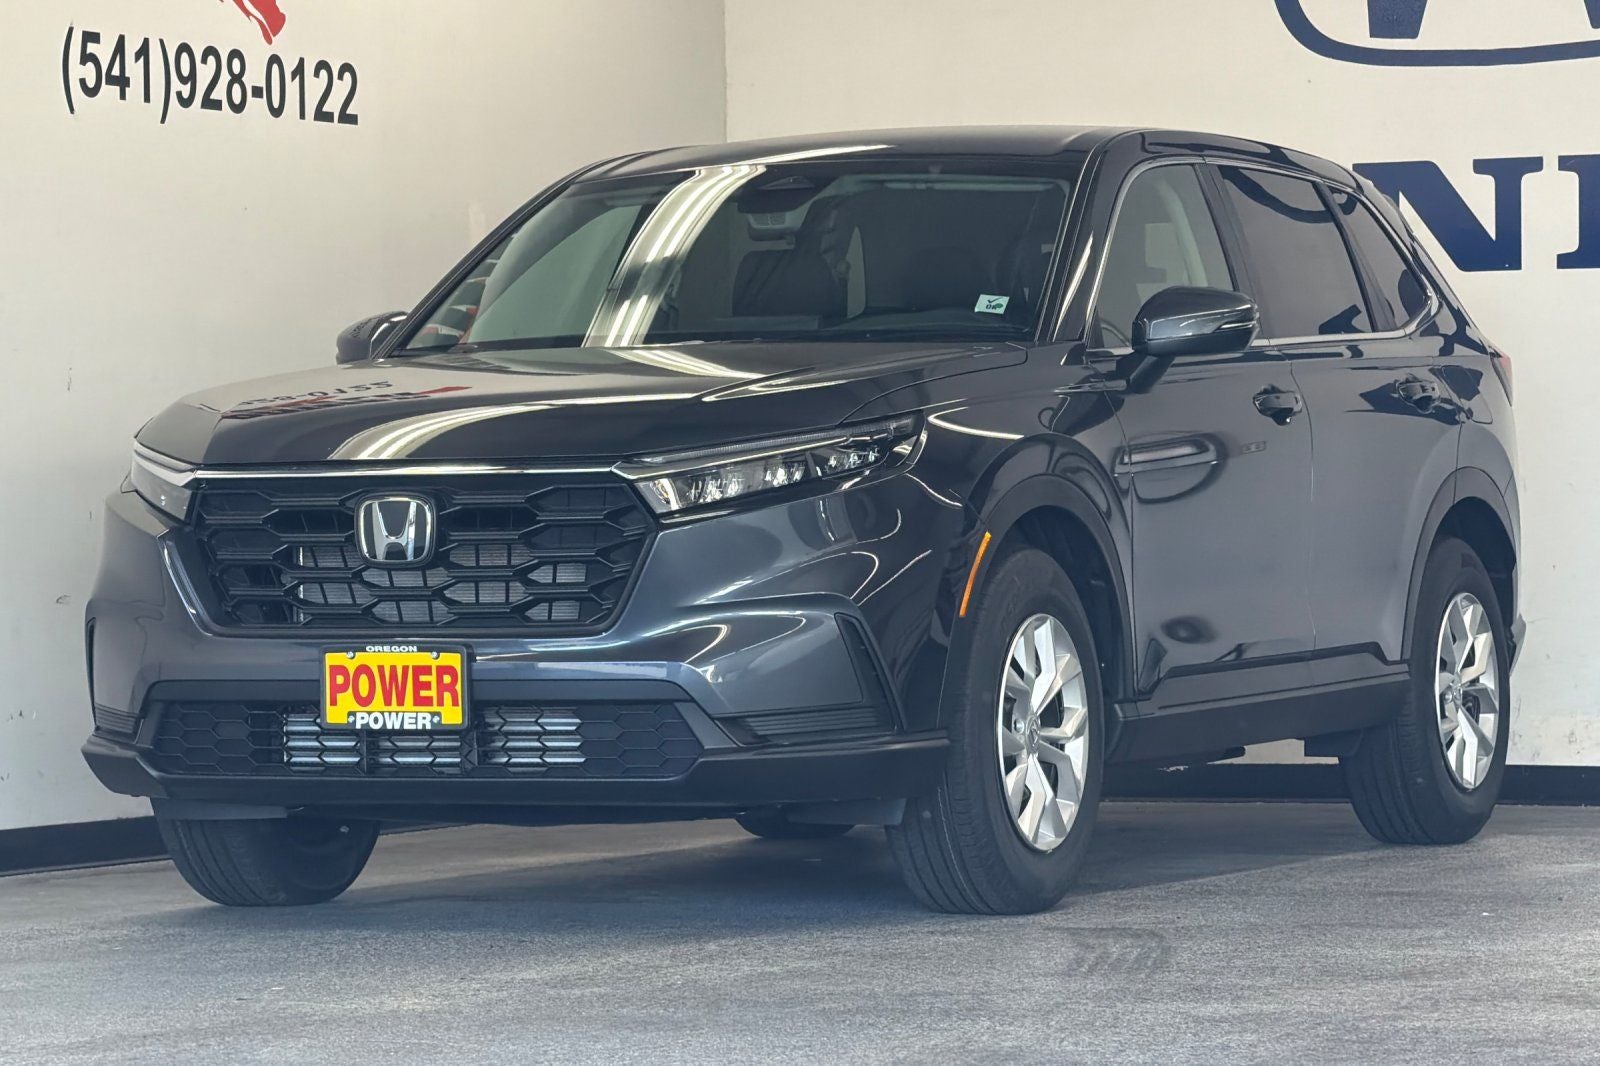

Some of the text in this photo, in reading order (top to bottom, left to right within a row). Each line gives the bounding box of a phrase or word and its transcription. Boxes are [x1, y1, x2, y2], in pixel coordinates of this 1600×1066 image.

[62, 25, 359, 126] (541)928-0122
[329, 664, 460, 707] POWER
[355, 712, 432, 730] POWER
